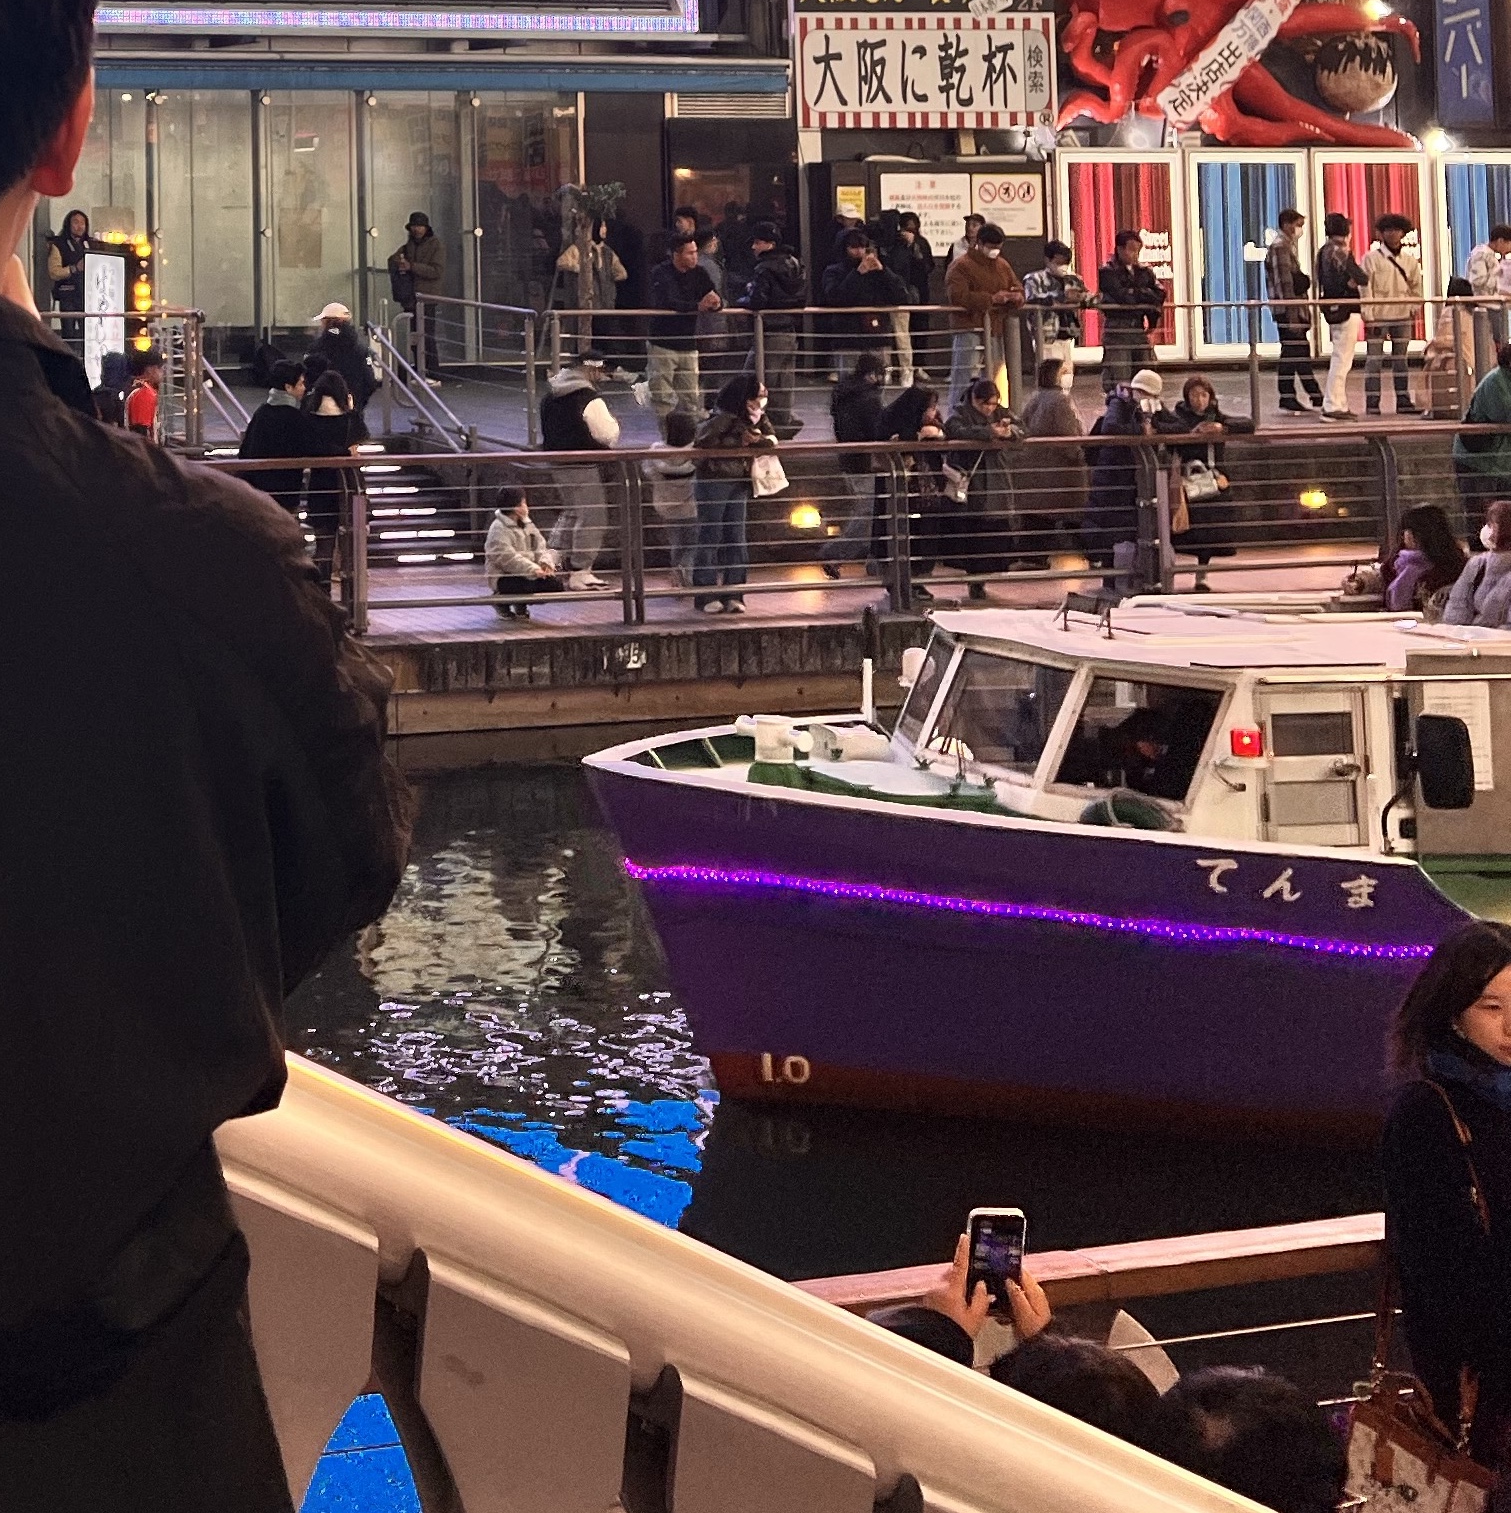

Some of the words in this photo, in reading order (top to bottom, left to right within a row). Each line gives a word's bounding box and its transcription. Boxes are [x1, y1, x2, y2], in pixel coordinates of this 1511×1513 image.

[812, 33, 1018, 110] 大阪に乾杯
[1027, 45, 1044, 93] 検索
[1195, 858, 1378, 908] てんま
